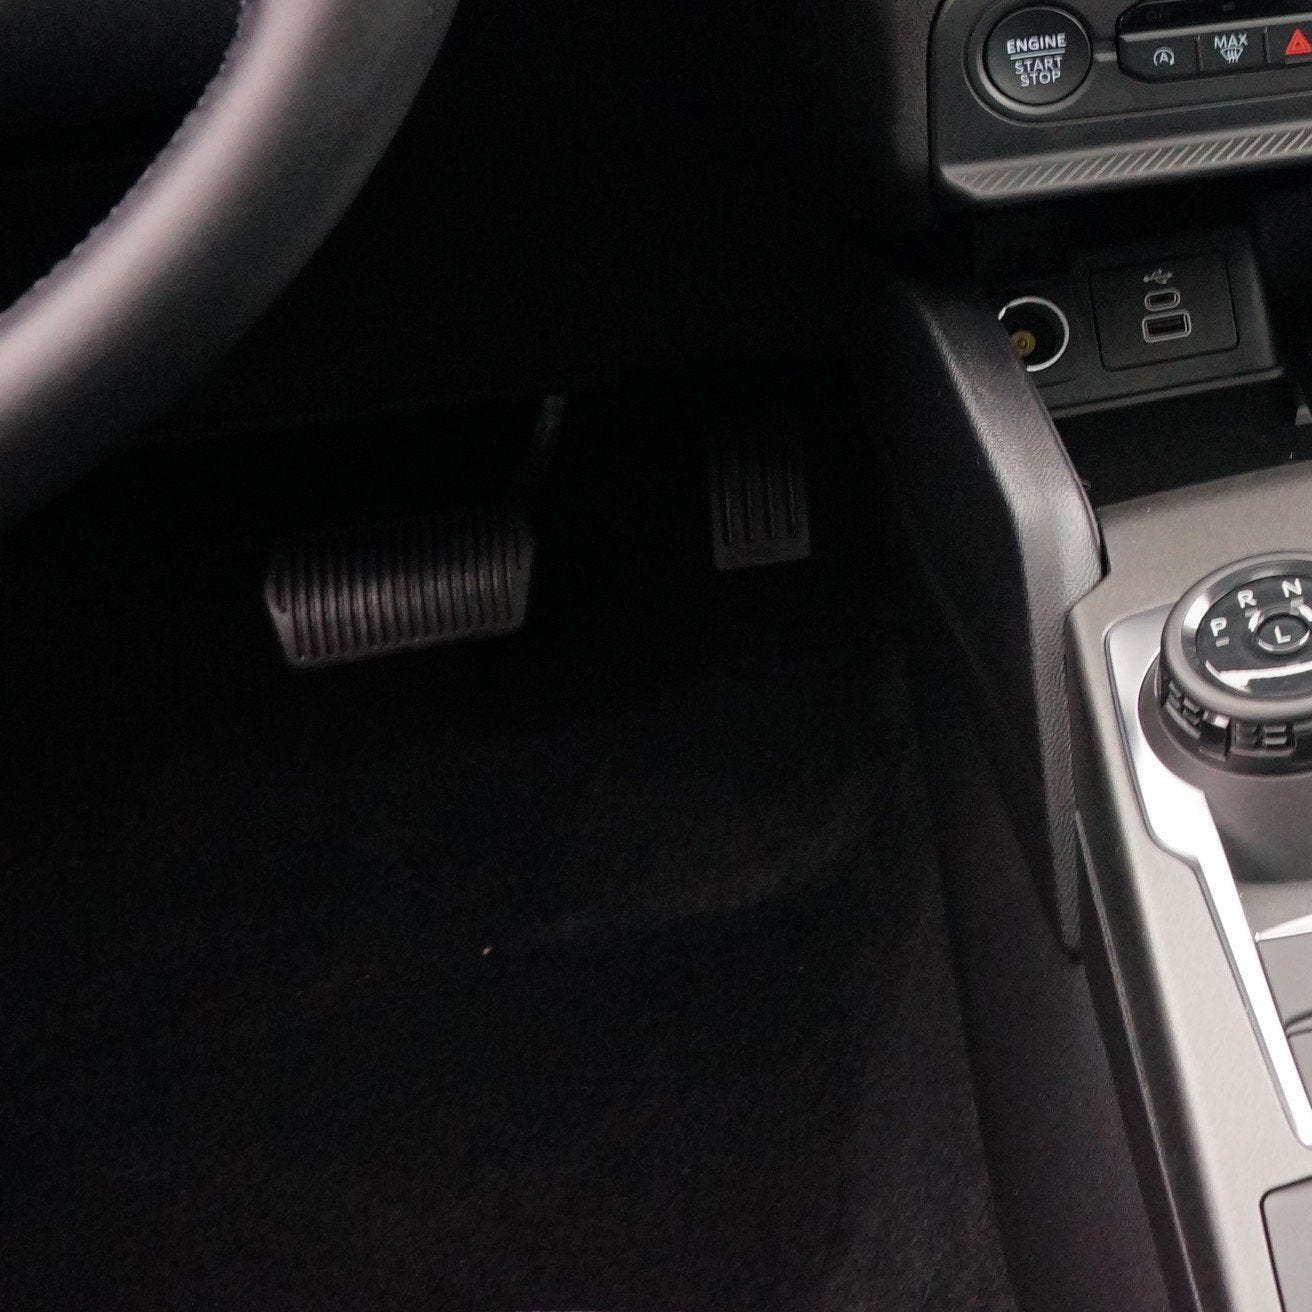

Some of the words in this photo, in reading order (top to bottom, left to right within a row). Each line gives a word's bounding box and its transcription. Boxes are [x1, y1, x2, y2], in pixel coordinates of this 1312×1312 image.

[1006, 32, 1067, 54] ENGINE
[1214, 32, 1248, 49] MAX
[1015, 54, 1063, 75] START
[1020, 68, 1061, 87] STOP
[1210, 617, 1228, 637] P
[1237, 589, 1257, 609] R
[1281, 577, 1302, 598] N
[1274, 625, 1292, 644] L
